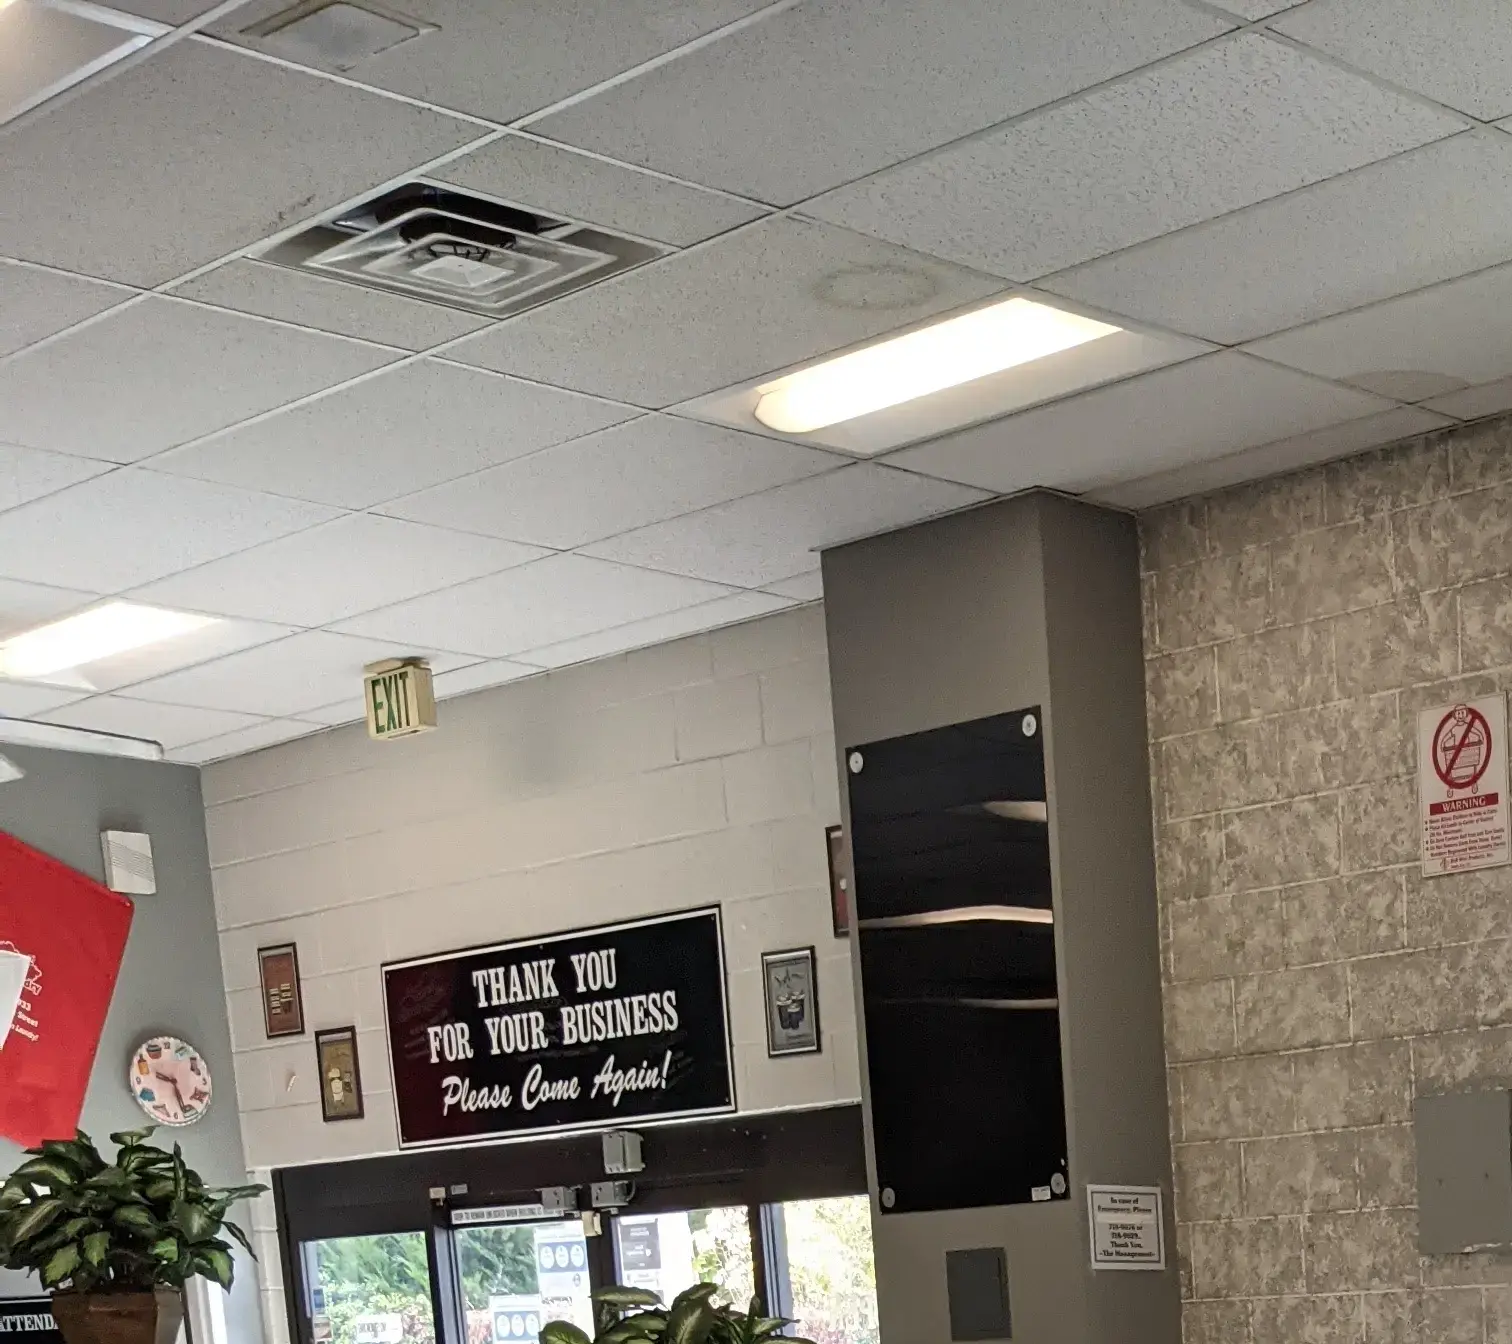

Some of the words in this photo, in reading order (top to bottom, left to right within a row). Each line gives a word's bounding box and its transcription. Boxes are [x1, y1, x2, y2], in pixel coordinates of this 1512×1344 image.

[371, 671, 410, 734] EXIT
[1441, 796, 1486, 812] WARNING
[472, 959, 559, 1008] THANK
[571, 948, 617, 993] YOU
[428, 1022, 474, 1064] FOR
[484, 1012, 549, 1056] YOUR
[561, 990, 679, 1045] BUSINESS
[441, 1074, 512, 1117] Please
[521, 1063, 581, 1111] Come
[591, 1050, 673, 1107] Again!
[0, 1313, 59, 1332] ATTEND
